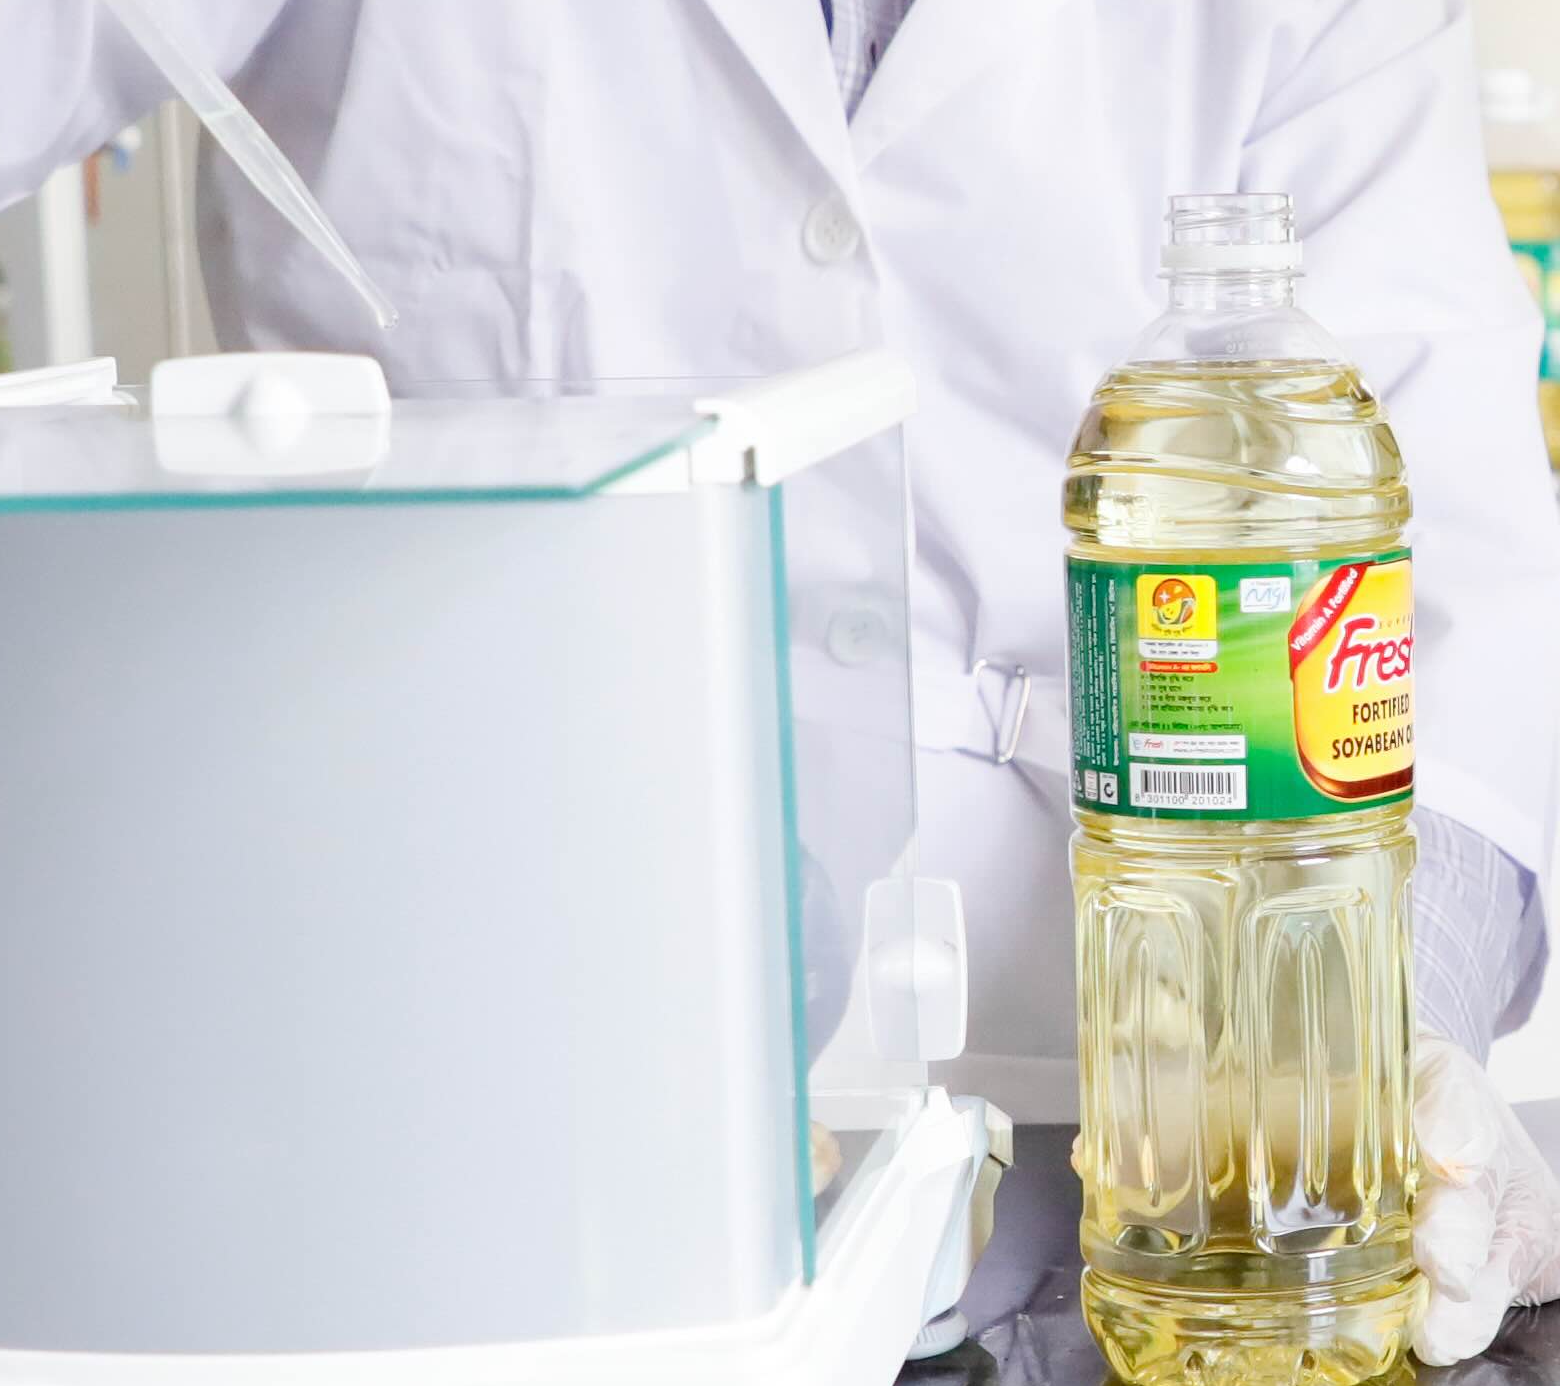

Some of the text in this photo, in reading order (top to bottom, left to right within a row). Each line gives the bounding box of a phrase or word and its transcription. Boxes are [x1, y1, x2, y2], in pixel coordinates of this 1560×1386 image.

[1291, 615, 1326, 651] Vitamin
[1329, 568, 1358, 607] Fortified
[1328, 617, 1415, 690] Fres
[1352, 693, 1410, 724] FORTIFIED
[1332, 728, 1404, 760] SOYABEAN
[1192, 796, 1232, 805] 201024
